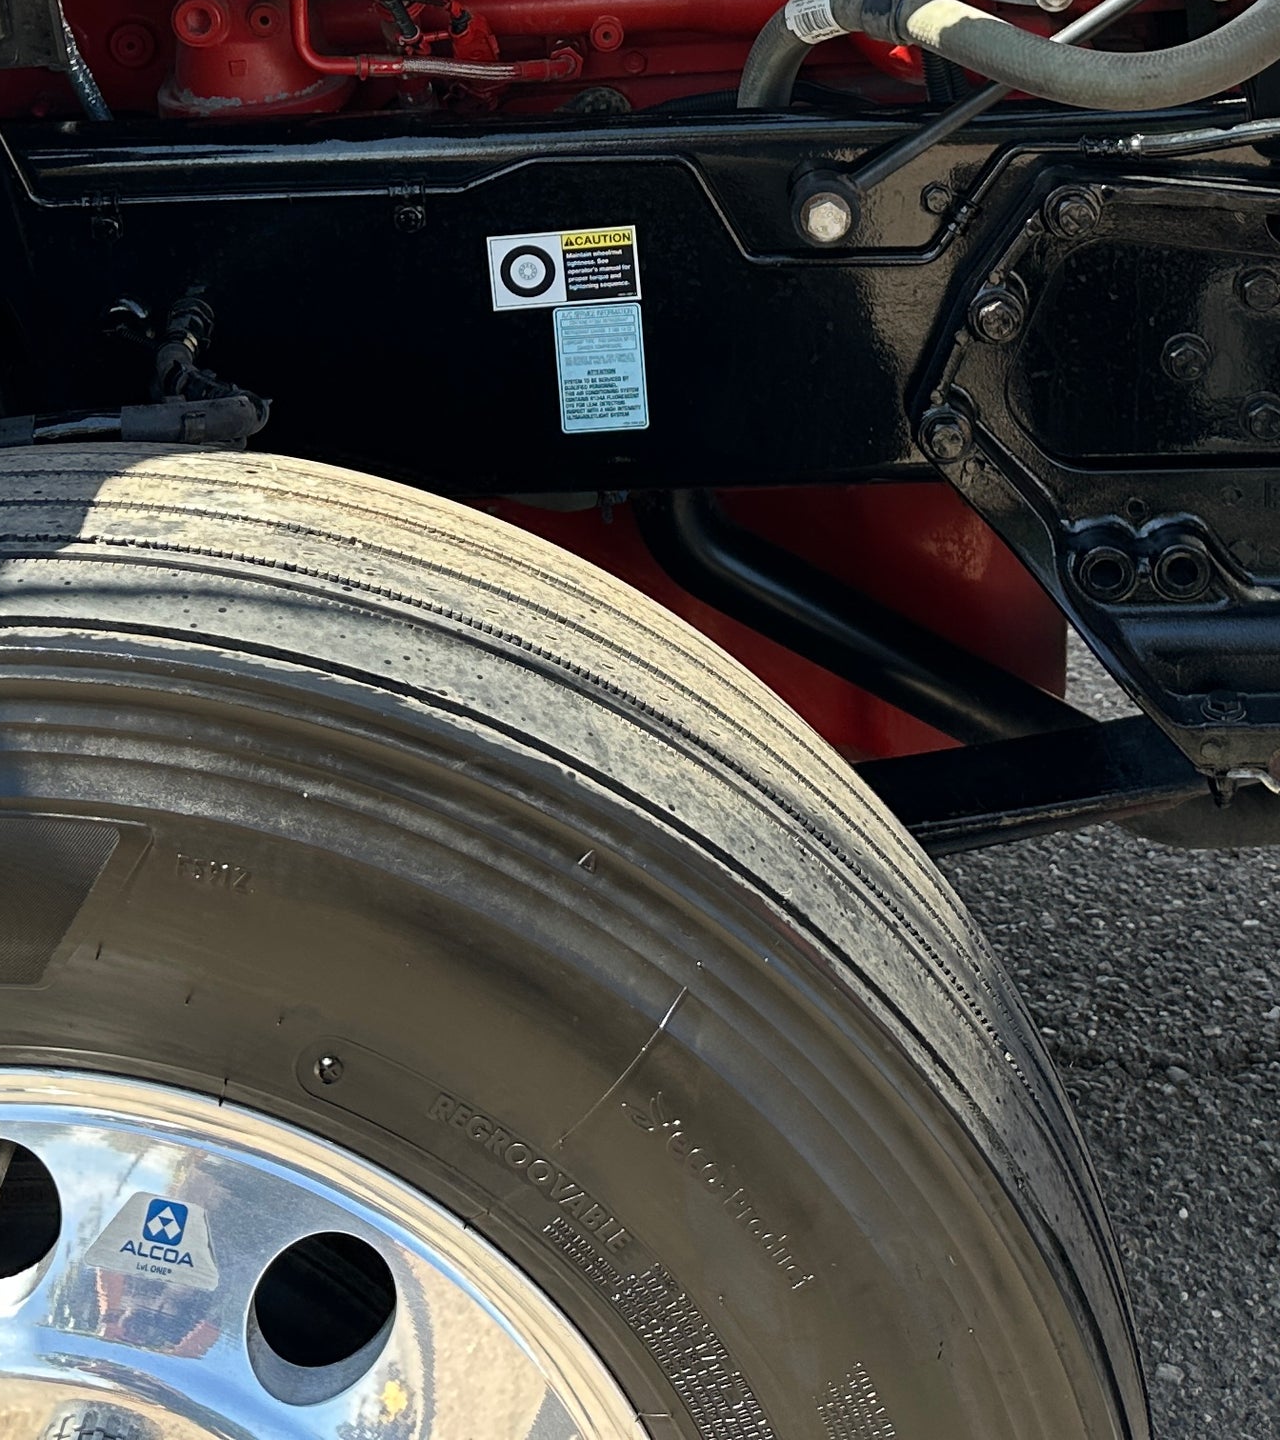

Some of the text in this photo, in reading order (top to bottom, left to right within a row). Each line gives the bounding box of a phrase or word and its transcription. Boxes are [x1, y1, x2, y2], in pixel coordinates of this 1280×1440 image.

[574, 232, 631, 246] CAUTION
[426, 1092, 635, 1255] REGROOVABLE
[119, 1239, 194, 1268] ALCOA
